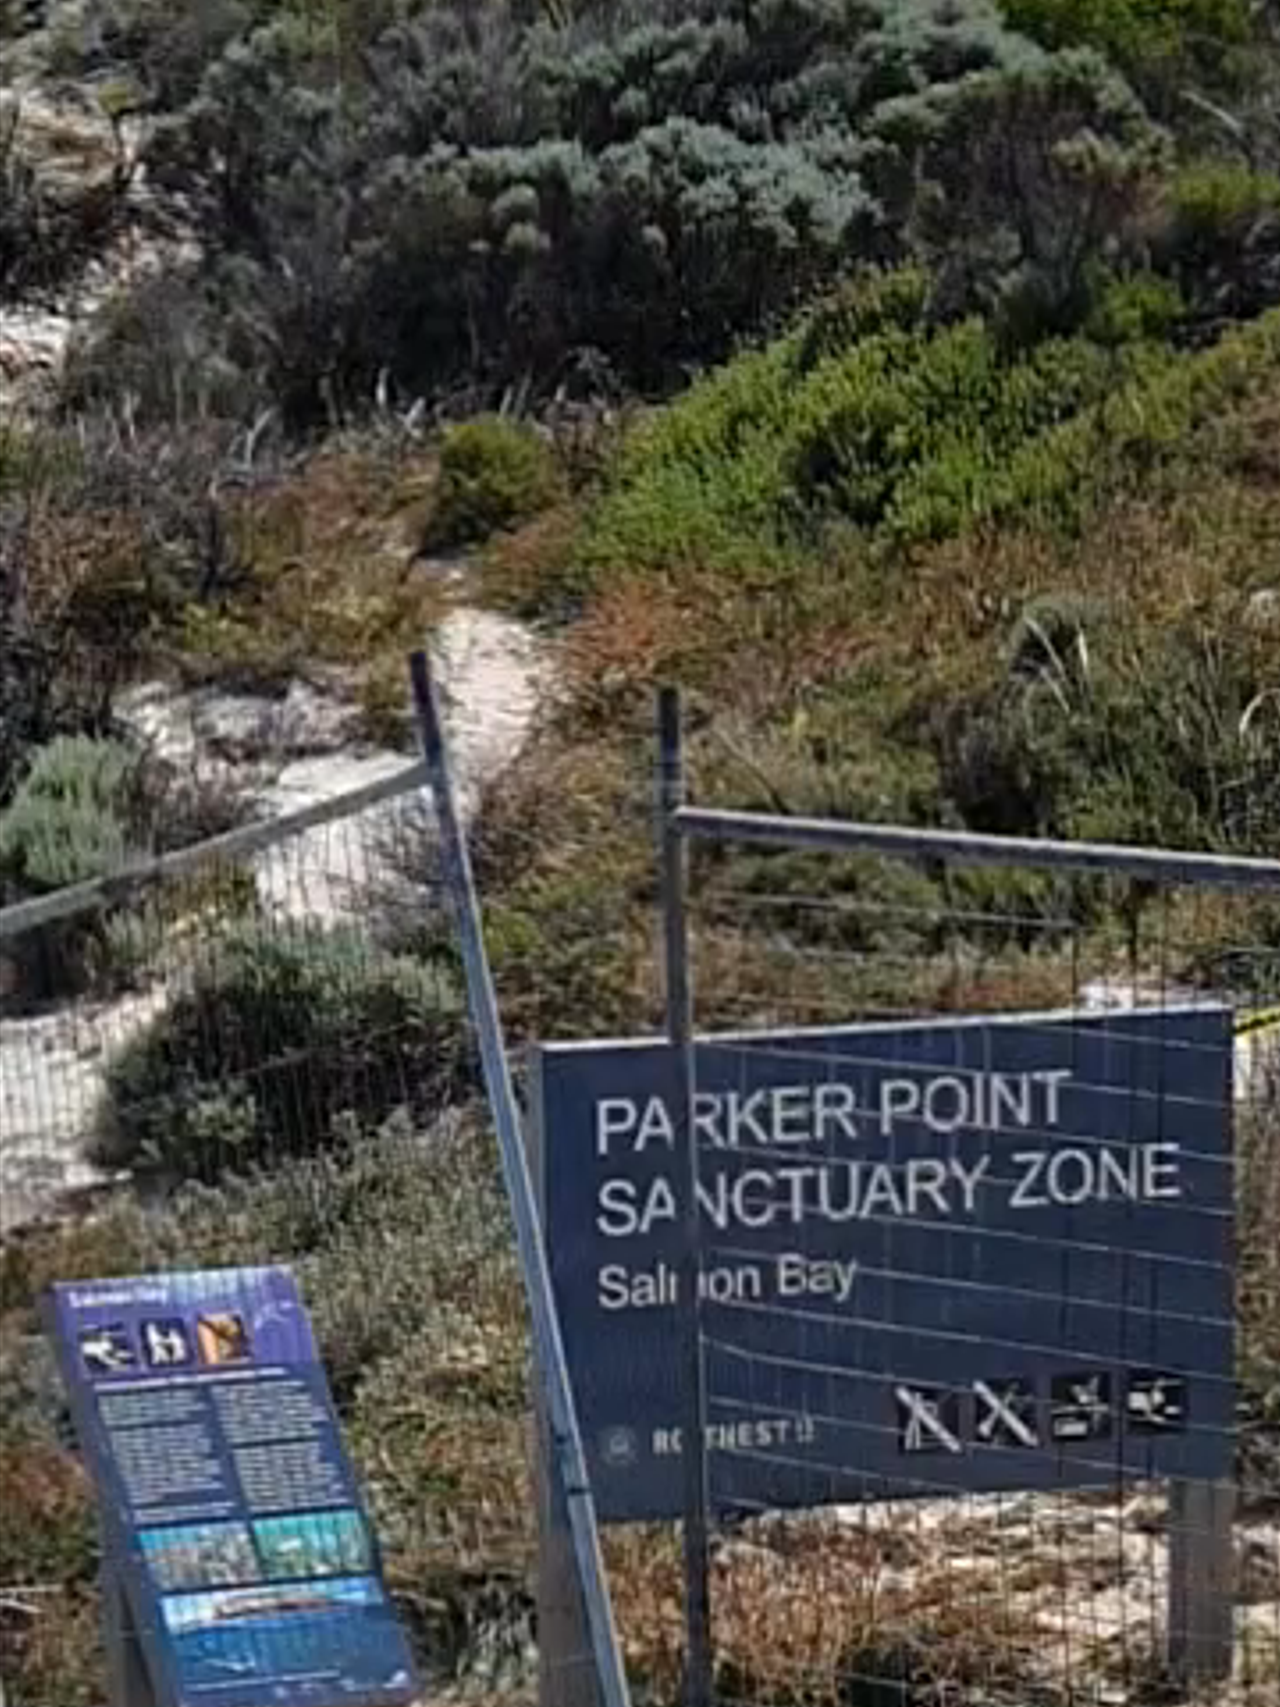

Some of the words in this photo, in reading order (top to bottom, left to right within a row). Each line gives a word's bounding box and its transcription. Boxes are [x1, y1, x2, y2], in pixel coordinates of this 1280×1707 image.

[596, 1082, 858, 1155] PARKER
[880, 1070, 1072, 1136] POINT
[596, 1154, 991, 1237] SANCTUARY
[1009, 1142, 1182, 1209] ZONE
[777, 1252, 858, 1302] Bay
[652, 1418, 792, 1455] ROTNEST
